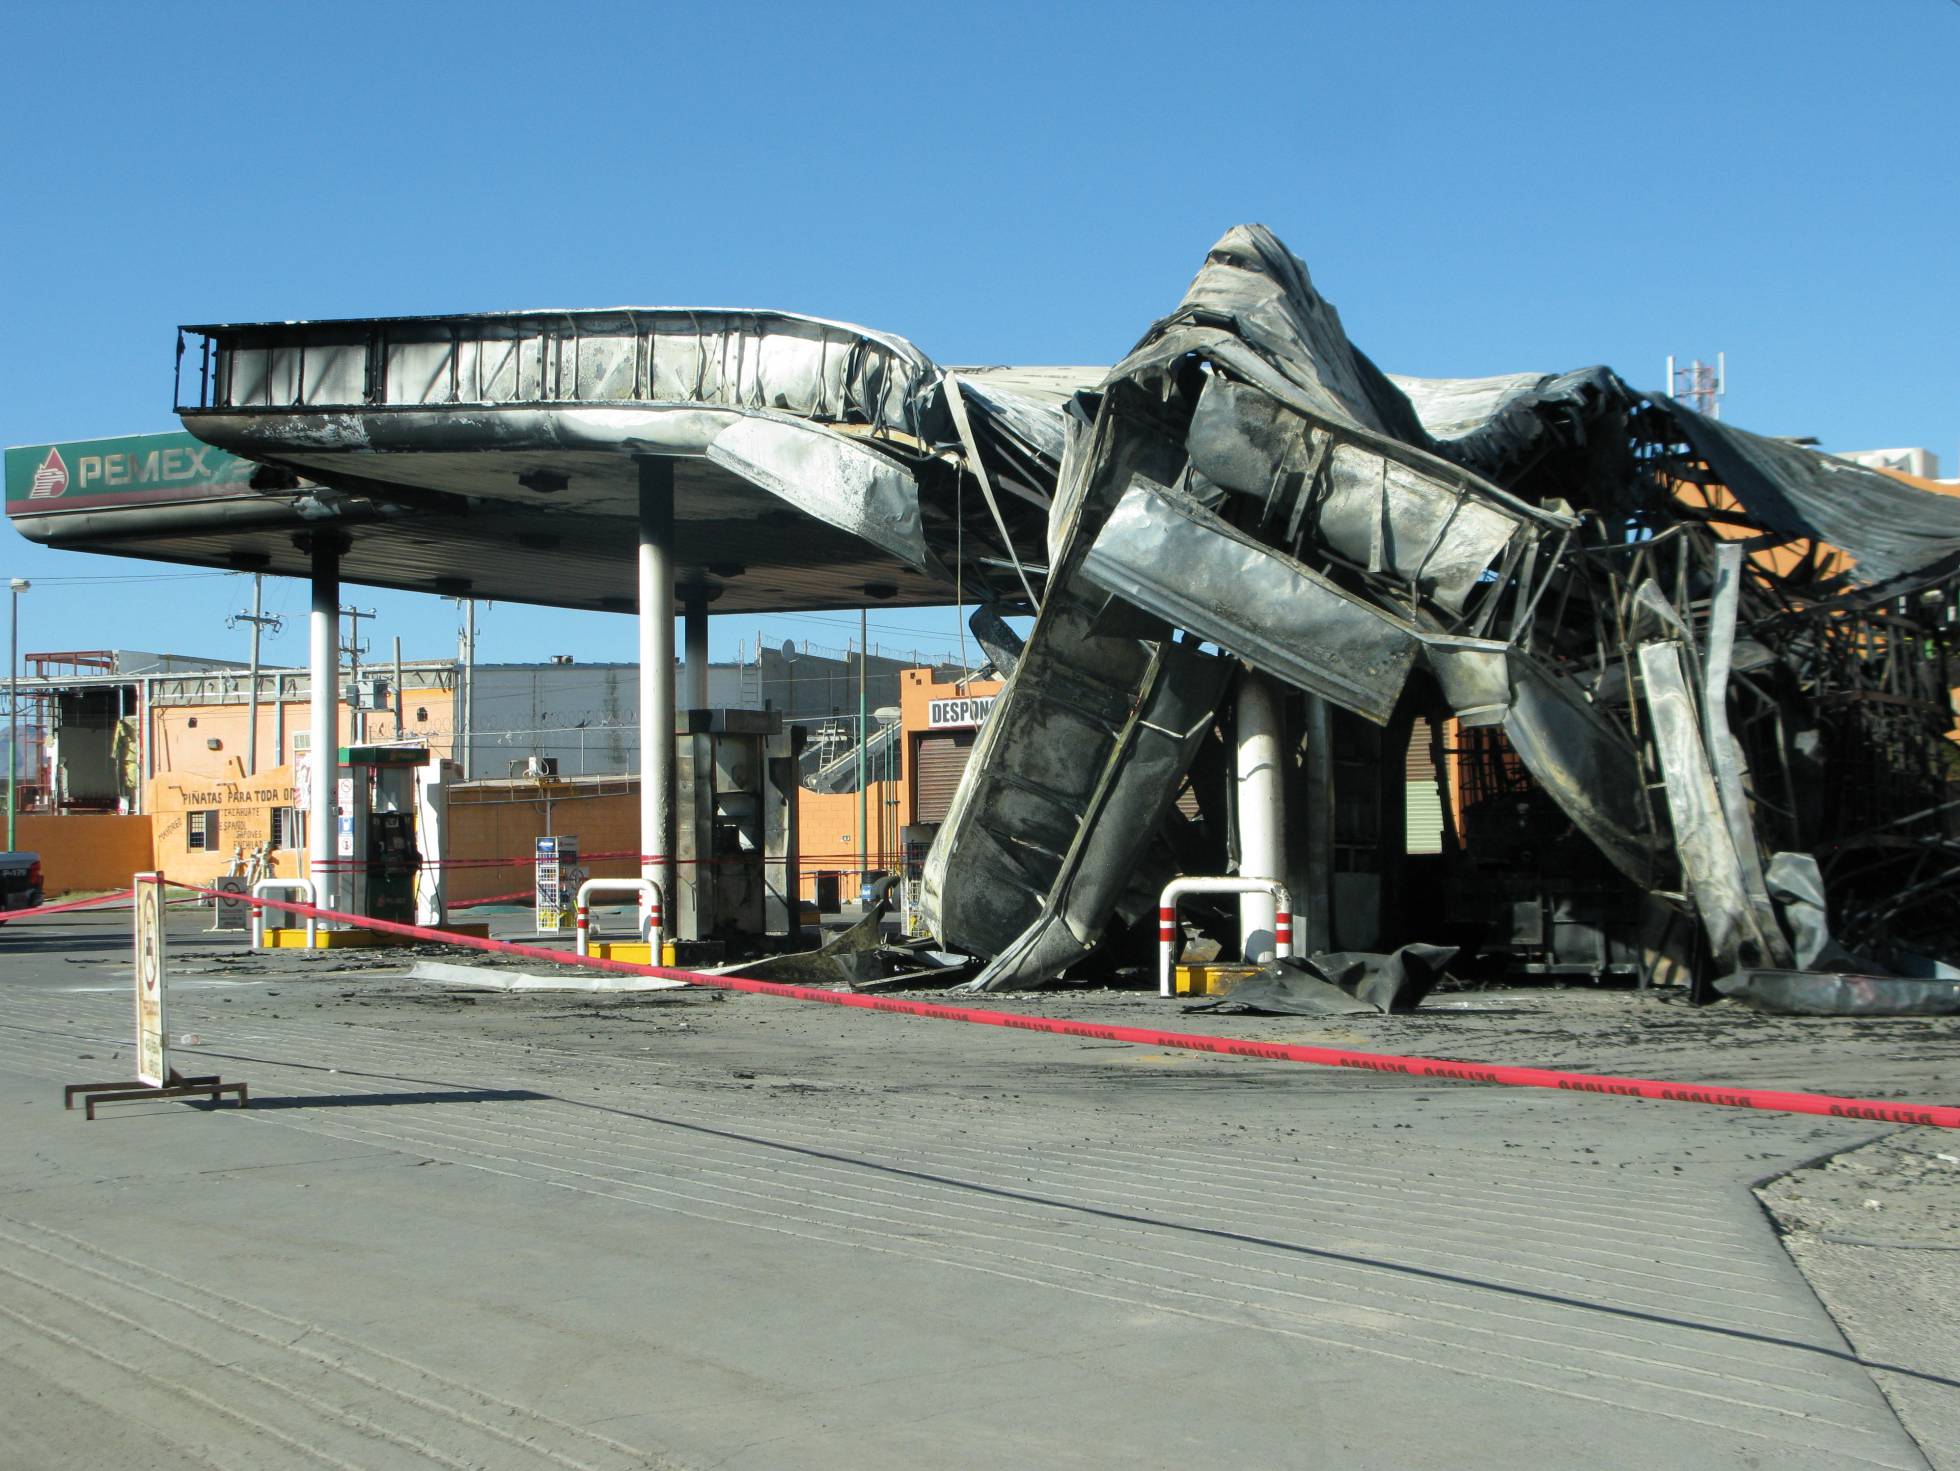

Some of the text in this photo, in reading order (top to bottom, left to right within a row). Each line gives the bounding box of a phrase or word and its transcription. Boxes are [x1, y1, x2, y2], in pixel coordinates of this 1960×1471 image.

[79, 447, 212, 489] PEMEX
[183, 790, 222, 805] PIÑATAS
[228, 791, 252, 804] PARA
[254, 789, 278, 802] TODA
